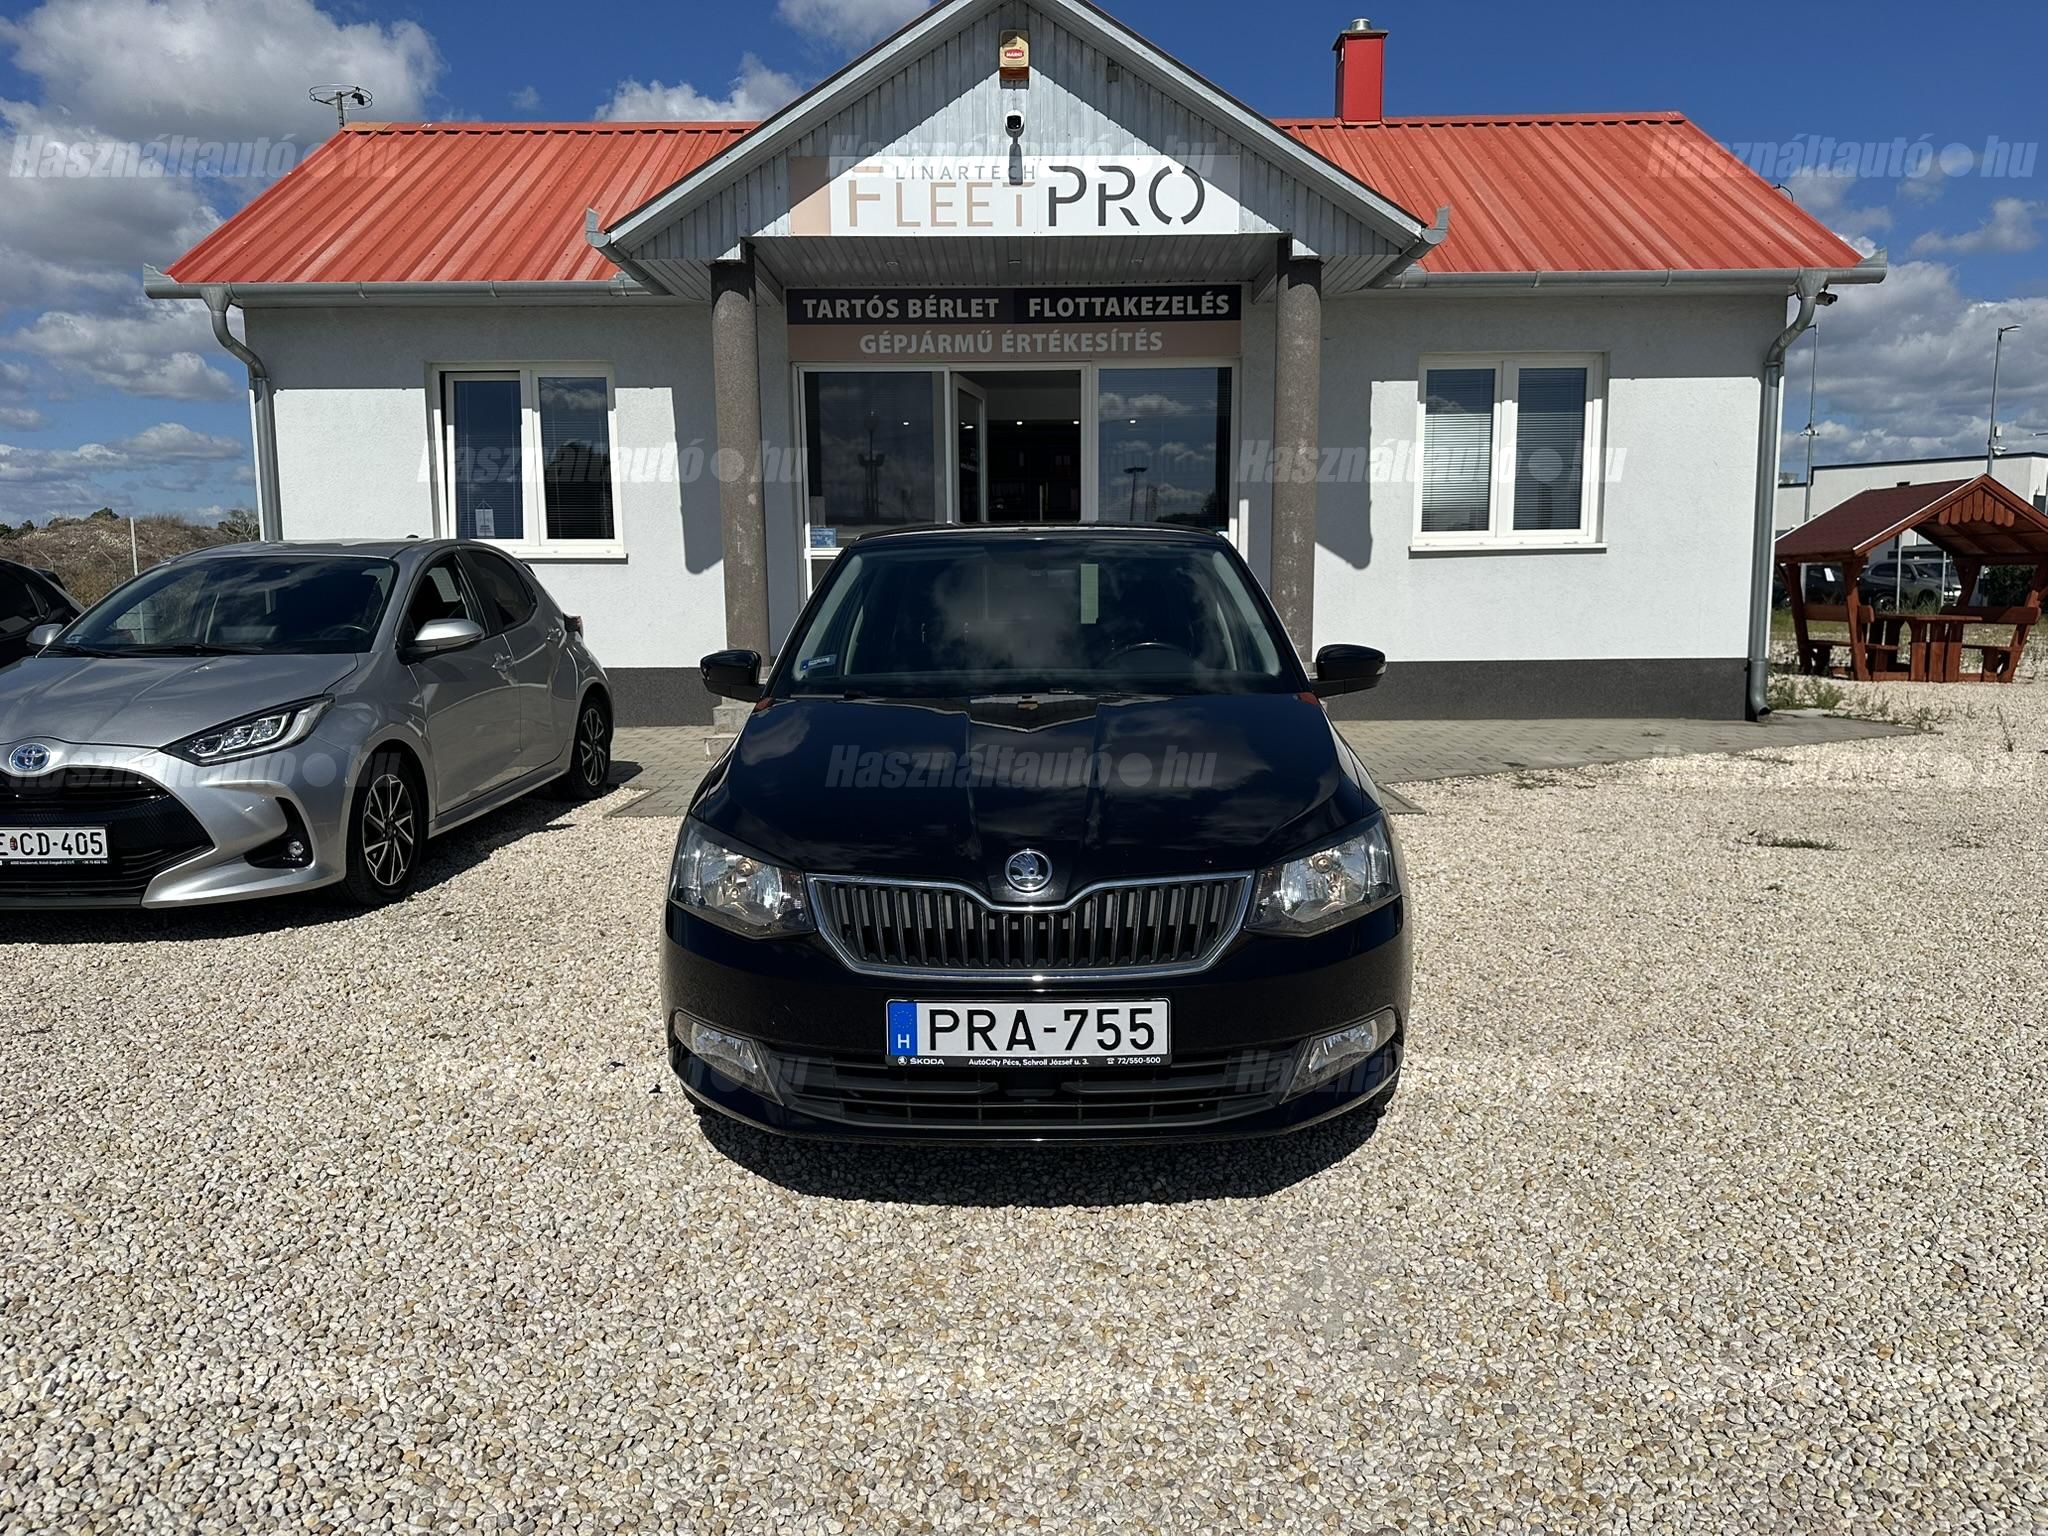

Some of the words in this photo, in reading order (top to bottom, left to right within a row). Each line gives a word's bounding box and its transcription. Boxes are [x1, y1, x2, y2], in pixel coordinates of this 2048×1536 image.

[895, 164, 1036, 181] LINARTECH
[803, 294, 900, 318] TARTÓS
[907, 295, 1000, 318] BÉRLET
[1029, 291, 1231, 317] FLOTTAKEZELÉS
[859, 329, 994, 354] GÉPJÁRMŰ
[1001, 327, 1164, 353] ÉRTÉKESÍTÉS
[20, 832, 103, 856] CD-405
[897, 1033, 910, 1049] H
[929, 1008, 1155, 1051] PRA-755
[968, 1058, 1001, 1067] AutóCity
[1022, 1058, 1048, 1066] Schroll
[1049, 1058, 1073, 1066] József
[1117, 1056, 1161, 1065] 72/550-500
